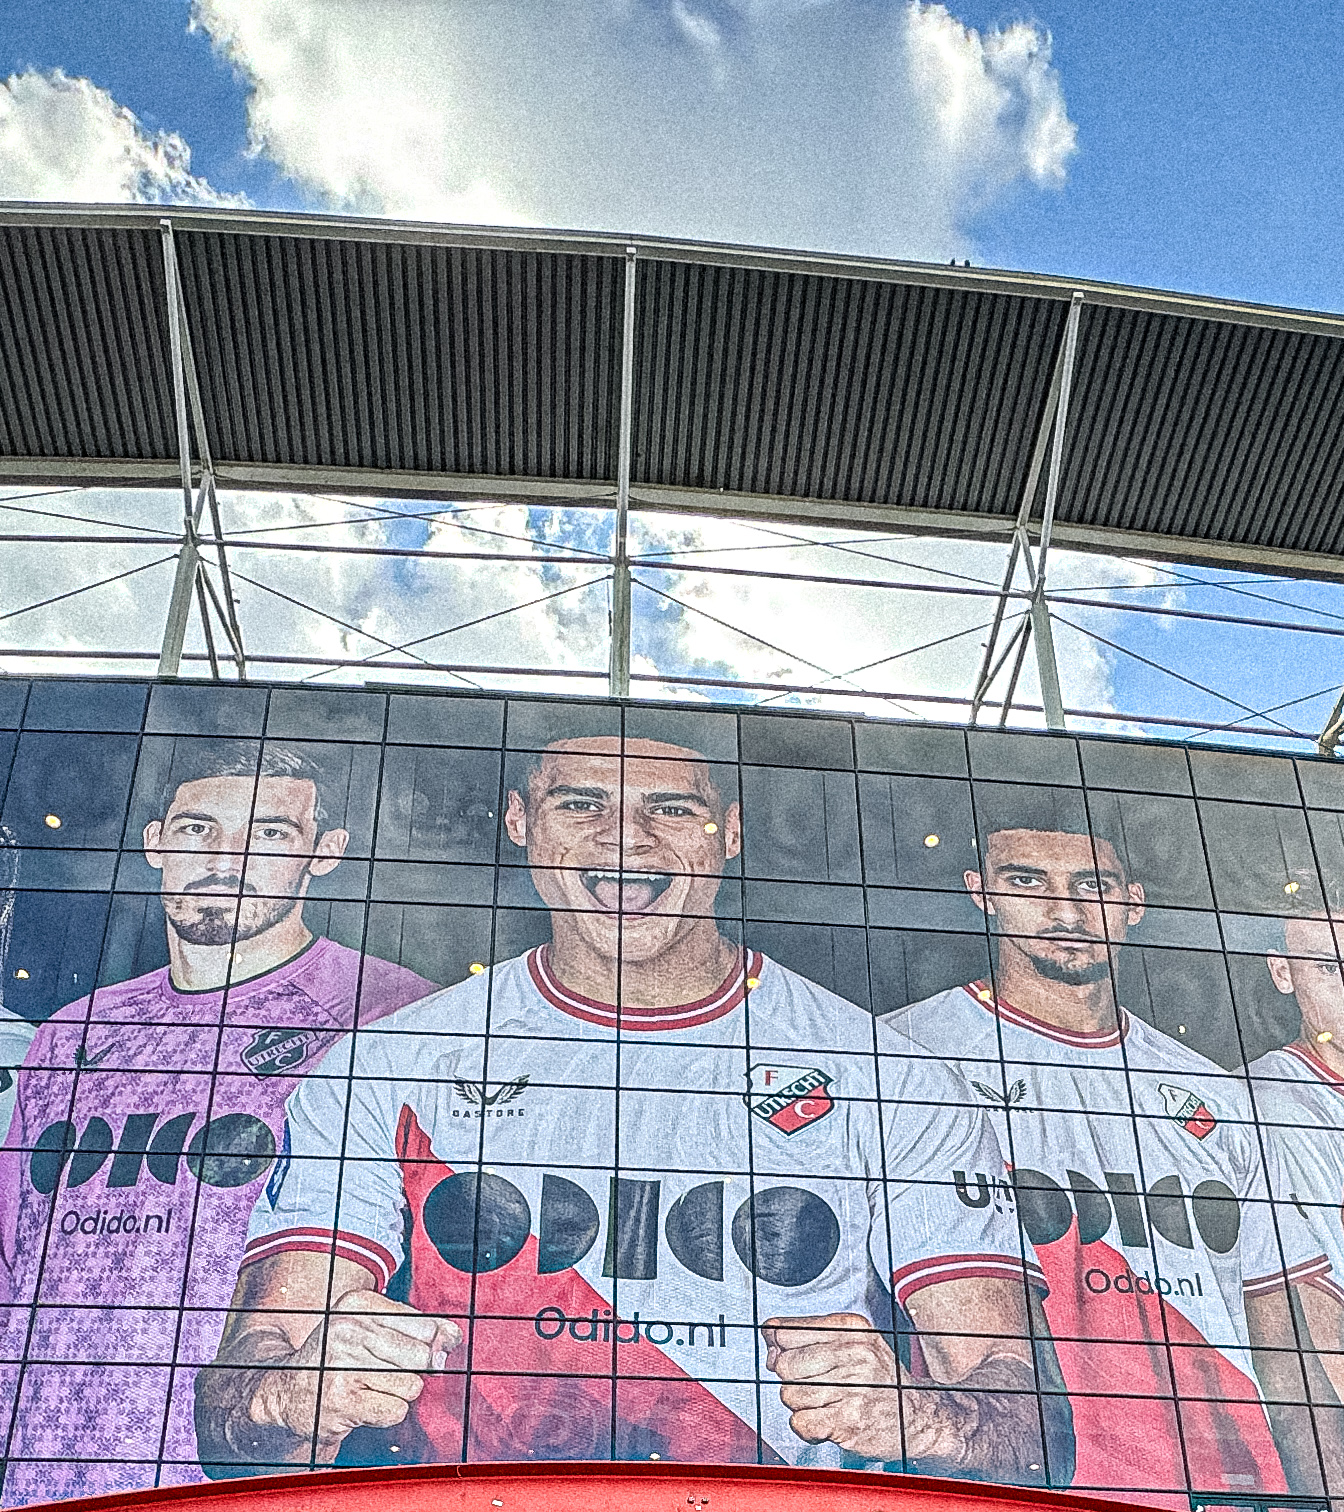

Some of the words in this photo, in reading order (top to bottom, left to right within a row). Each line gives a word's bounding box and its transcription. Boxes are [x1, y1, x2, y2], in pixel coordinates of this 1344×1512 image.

[764, 1070, 779, 1086] F
[794, 1100, 816, 1120] C
[60, 1207, 174, 1236] Odido.nl
[534, 1306, 727, 1348] Odido.nl
